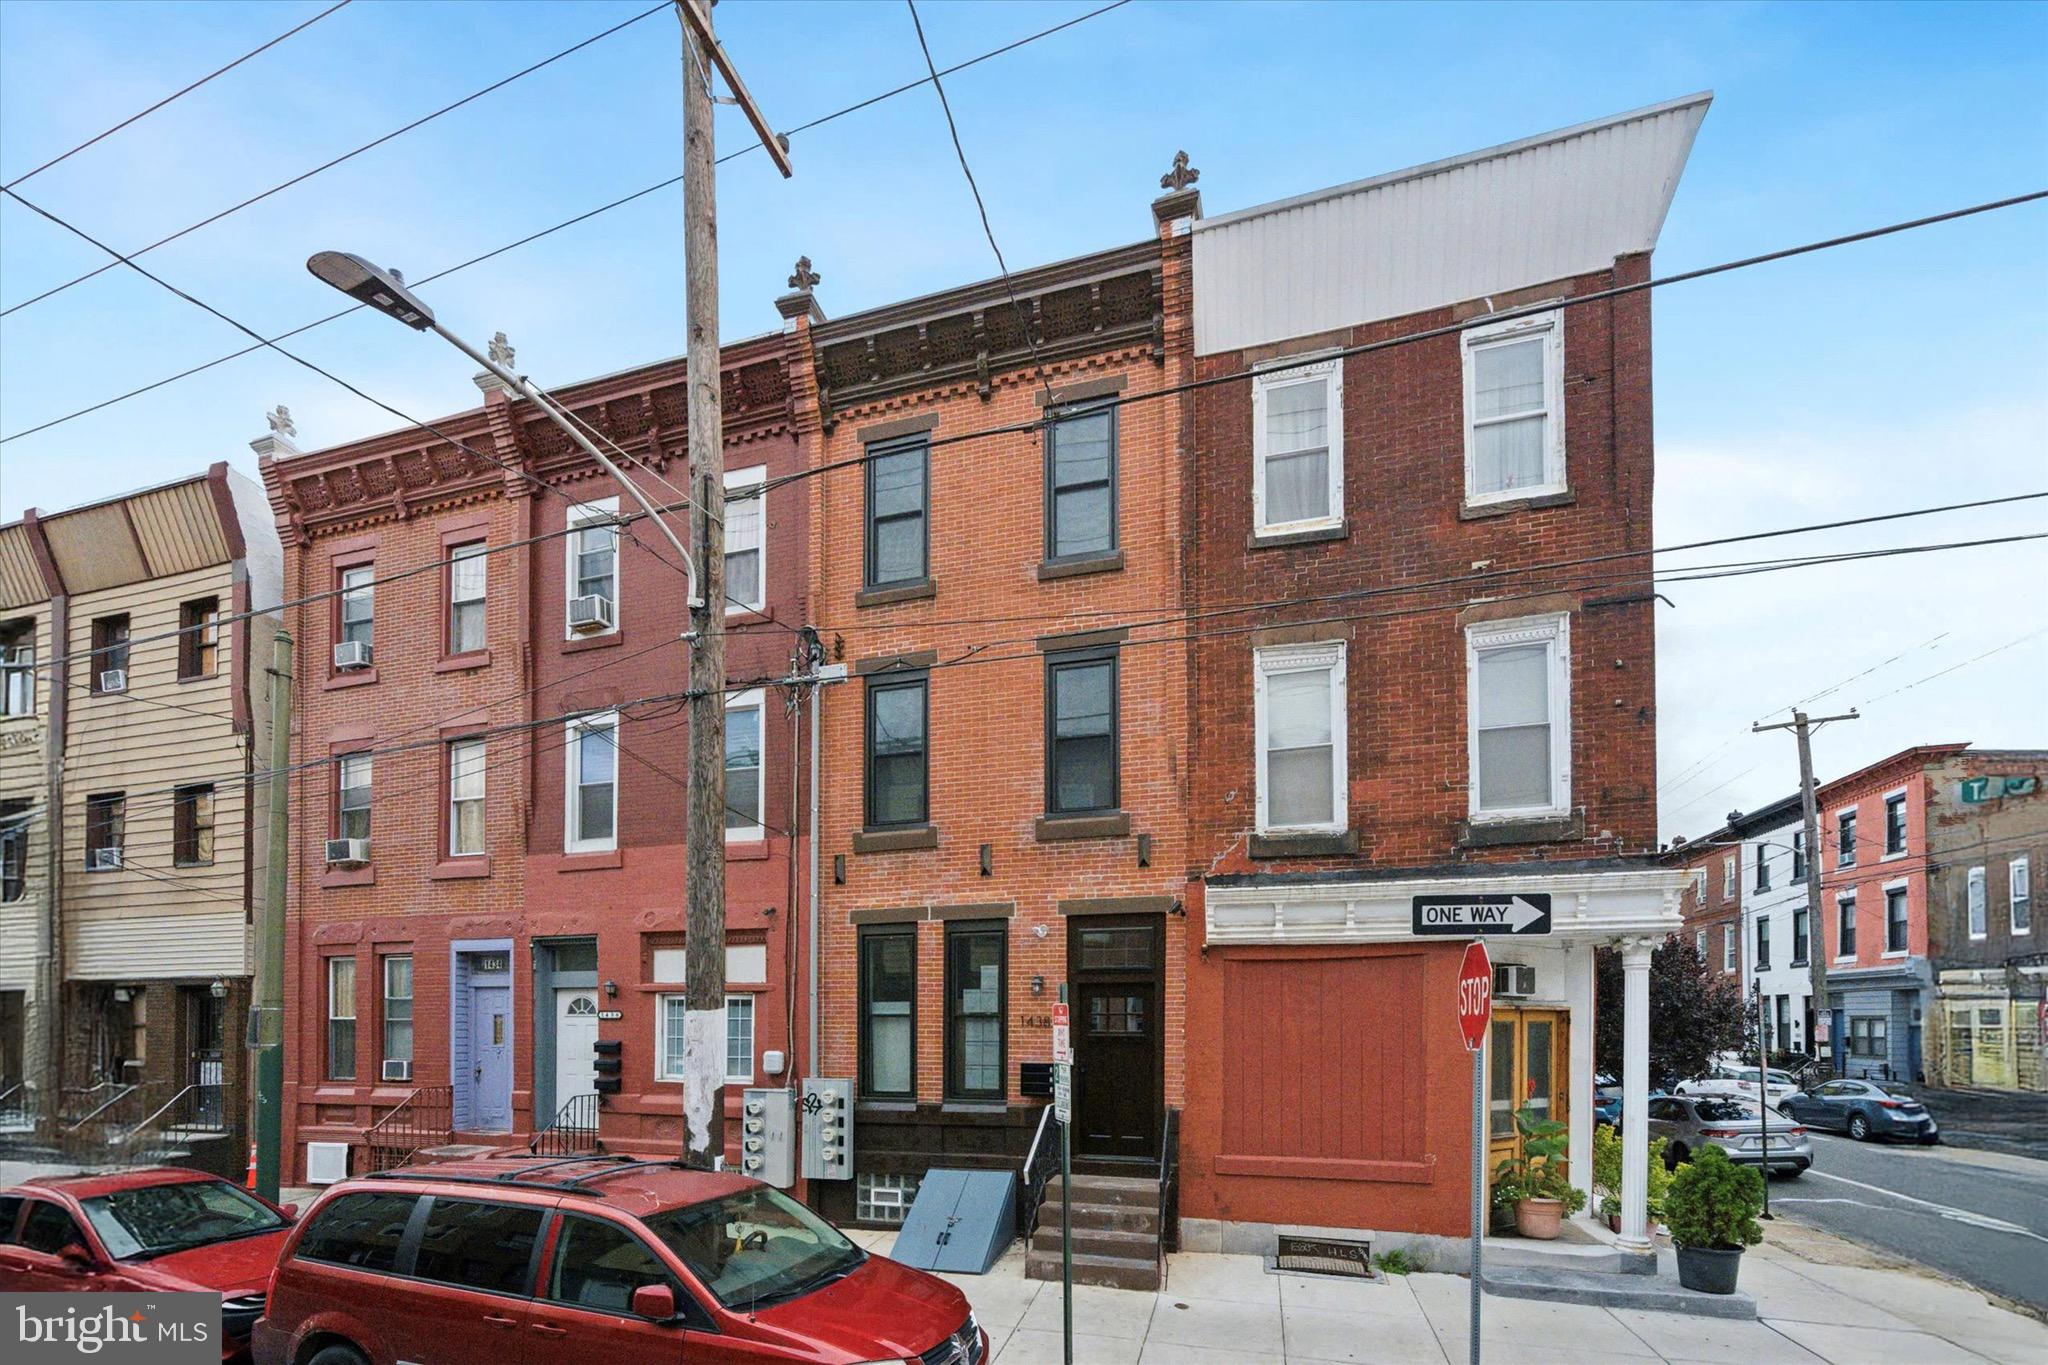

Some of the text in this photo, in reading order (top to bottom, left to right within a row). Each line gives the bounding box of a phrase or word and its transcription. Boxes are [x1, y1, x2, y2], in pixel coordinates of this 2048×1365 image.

[1426, 906, 1509, 923] ONE WAY
[1460, 976, 1489, 1016] STOP
[1020, 1015, 1051, 1028] 1438
